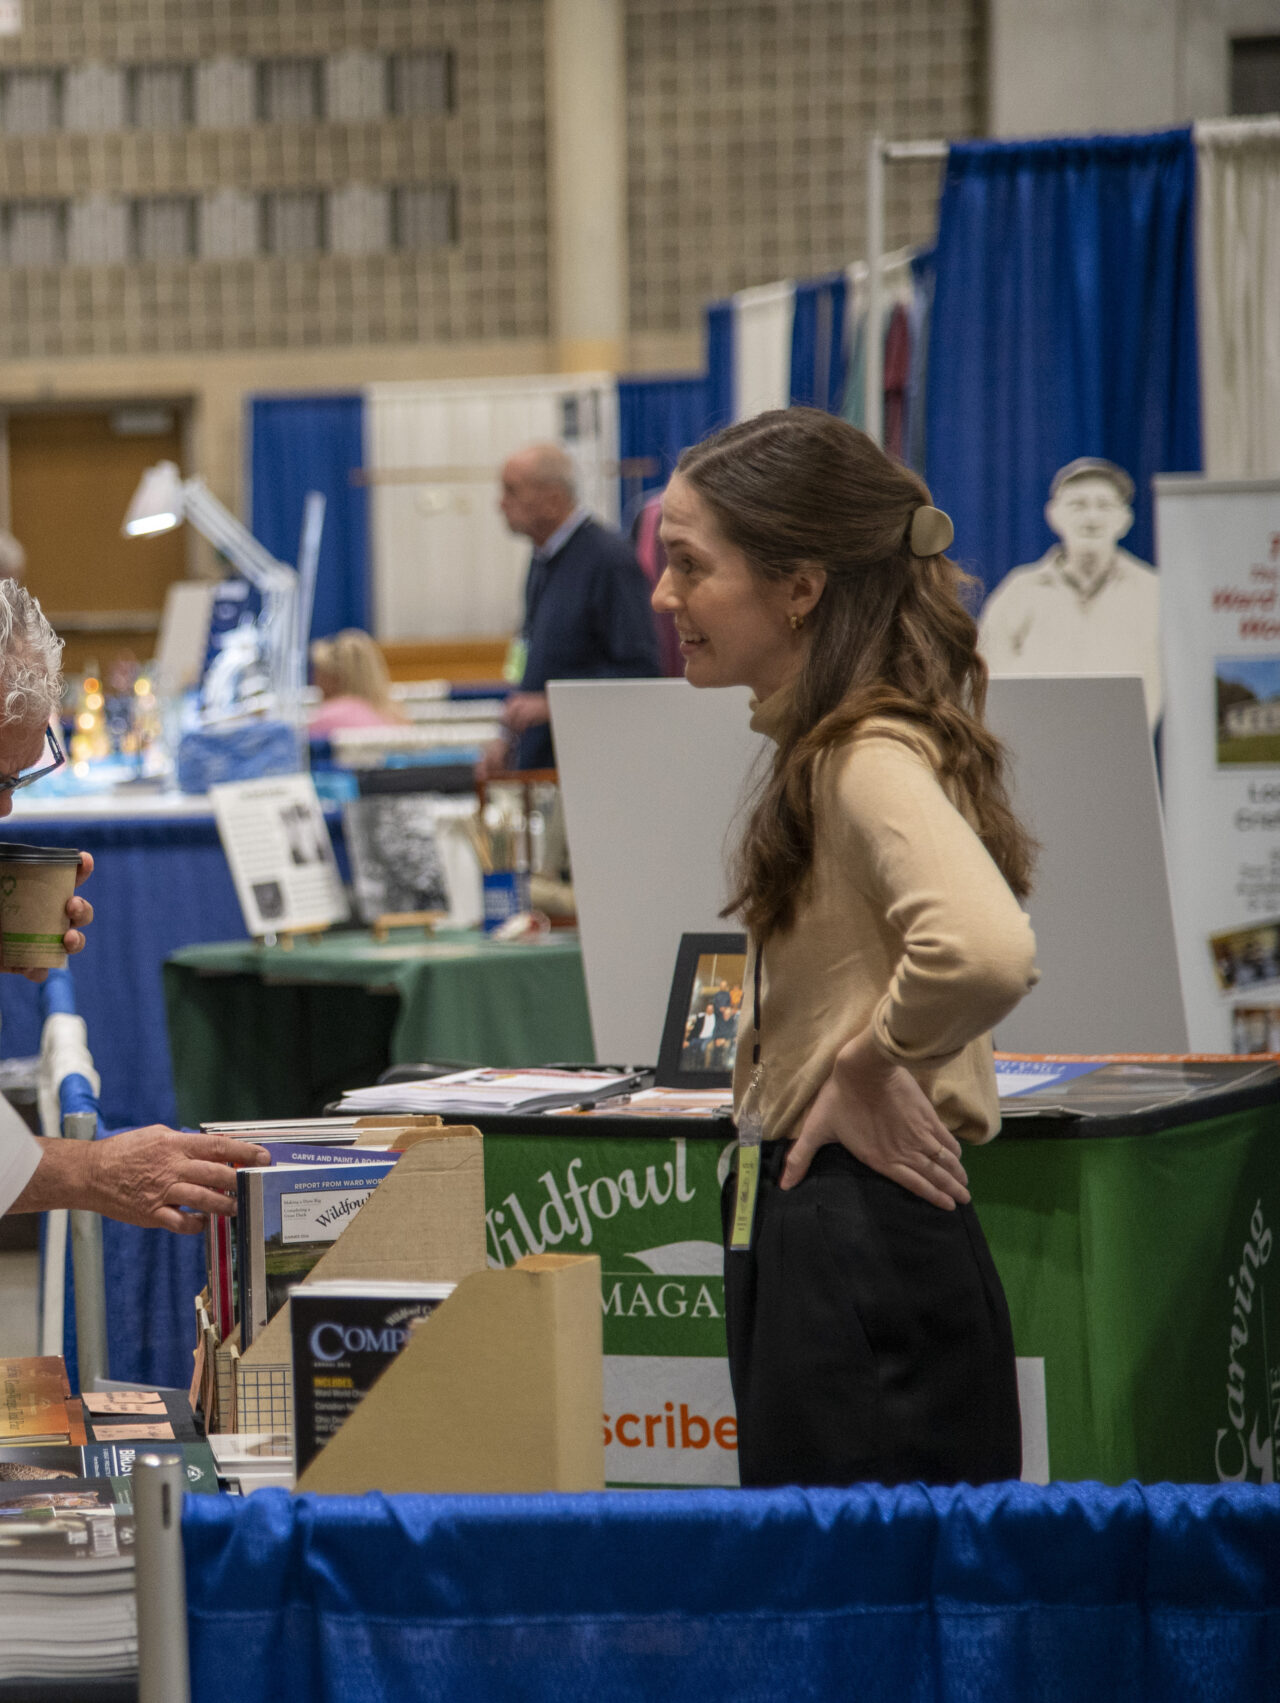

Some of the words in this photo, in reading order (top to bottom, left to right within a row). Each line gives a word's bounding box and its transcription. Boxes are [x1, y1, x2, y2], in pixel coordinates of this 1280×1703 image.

[291, 1152, 316, 1163] CARVE
[316, 1155, 332, 1163] AND
[333, 1156, 354, 1165] PAINT
[294, 1182, 321, 1190] REPORT
[322, 1180, 342, 1189] FROM
[343, 1179, 365, 1187] WARD
[366, 1178, 384, 1187] WOR
[602, 1283, 725, 1319] MAGA
[1215, 1199, 1272, 1483] Carving
